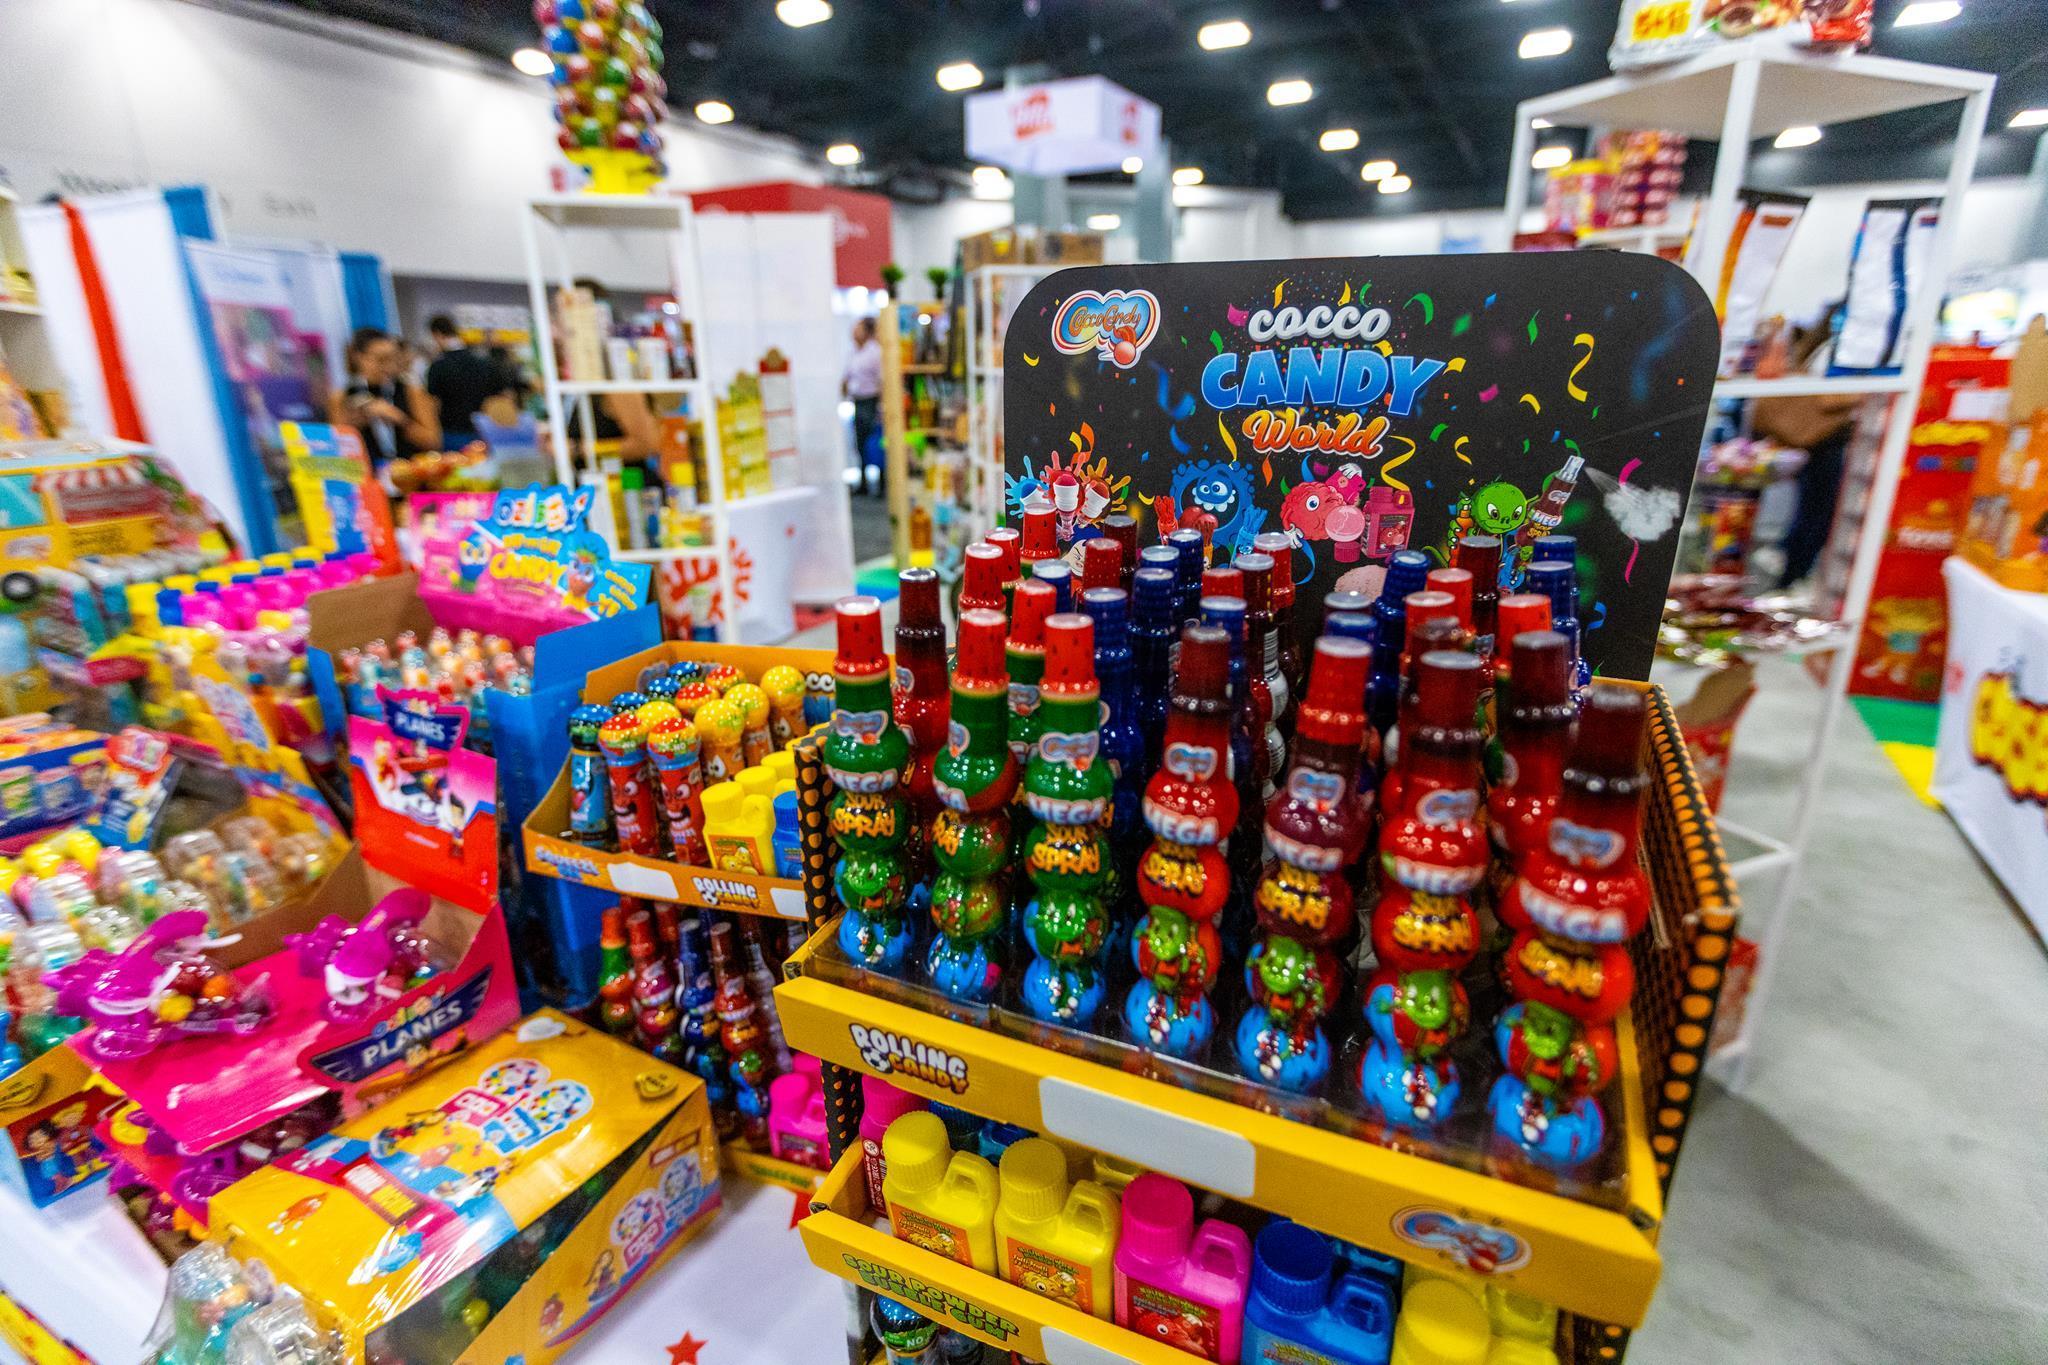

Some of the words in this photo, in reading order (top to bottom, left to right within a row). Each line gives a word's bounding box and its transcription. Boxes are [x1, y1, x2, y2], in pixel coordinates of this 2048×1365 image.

[1201, 347, 1445, 416] CANDY
[1241, 408, 1391, 460] World
[834, 808, 895, 838] SPRAY
[1033, 841, 1099, 875] SPRAY
[692, 876, 758, 901] ROLLING
[362, 999, 464, 1068] PLANES
[849, 1022, 969, 1081] ROLLING
[888, 1051, 969, 1095] CANDY
[841, 1252, 905, 1288] SOUR
[908, 1277, 1020, 1337] POWDER
[906, 1336, 924, 1347] NO
[949, 1308, 1009, 1343] GUM
